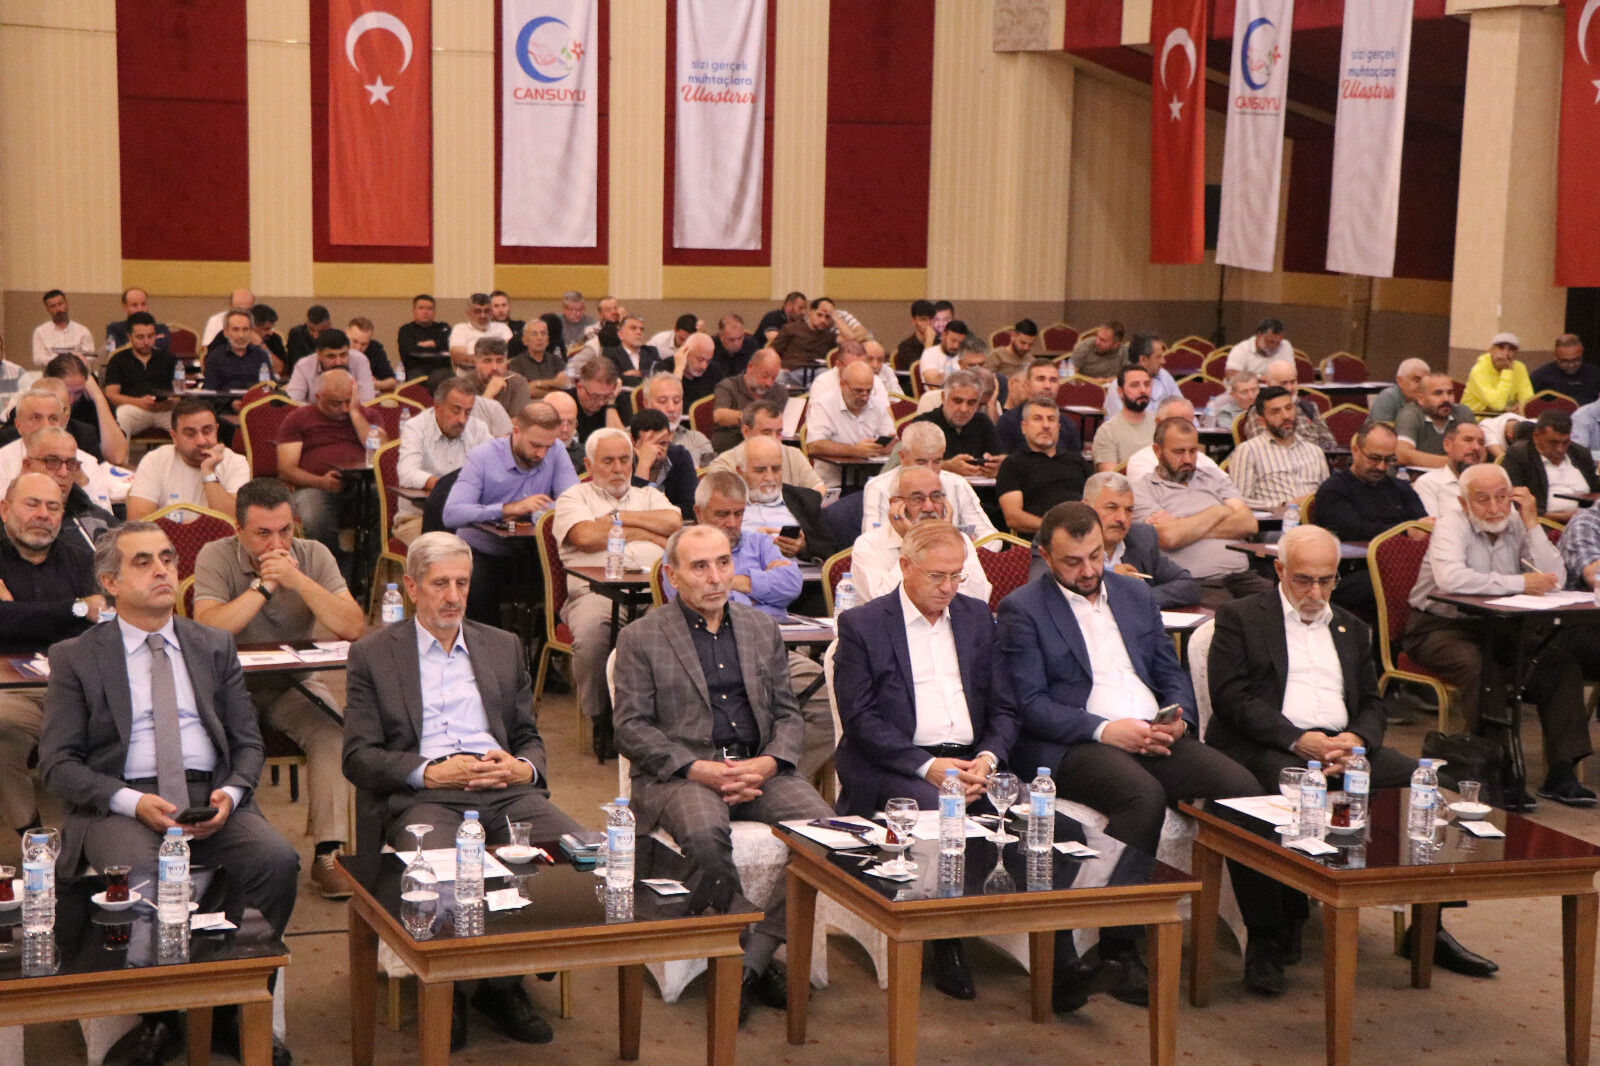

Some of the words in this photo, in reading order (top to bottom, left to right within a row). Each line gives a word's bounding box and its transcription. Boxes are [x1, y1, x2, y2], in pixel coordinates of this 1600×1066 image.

[711, 59, 748, 74] gerçek
[687, 73, 753, 88] muhtaçlara
[513, 87, 586, 102] CANSUYU
